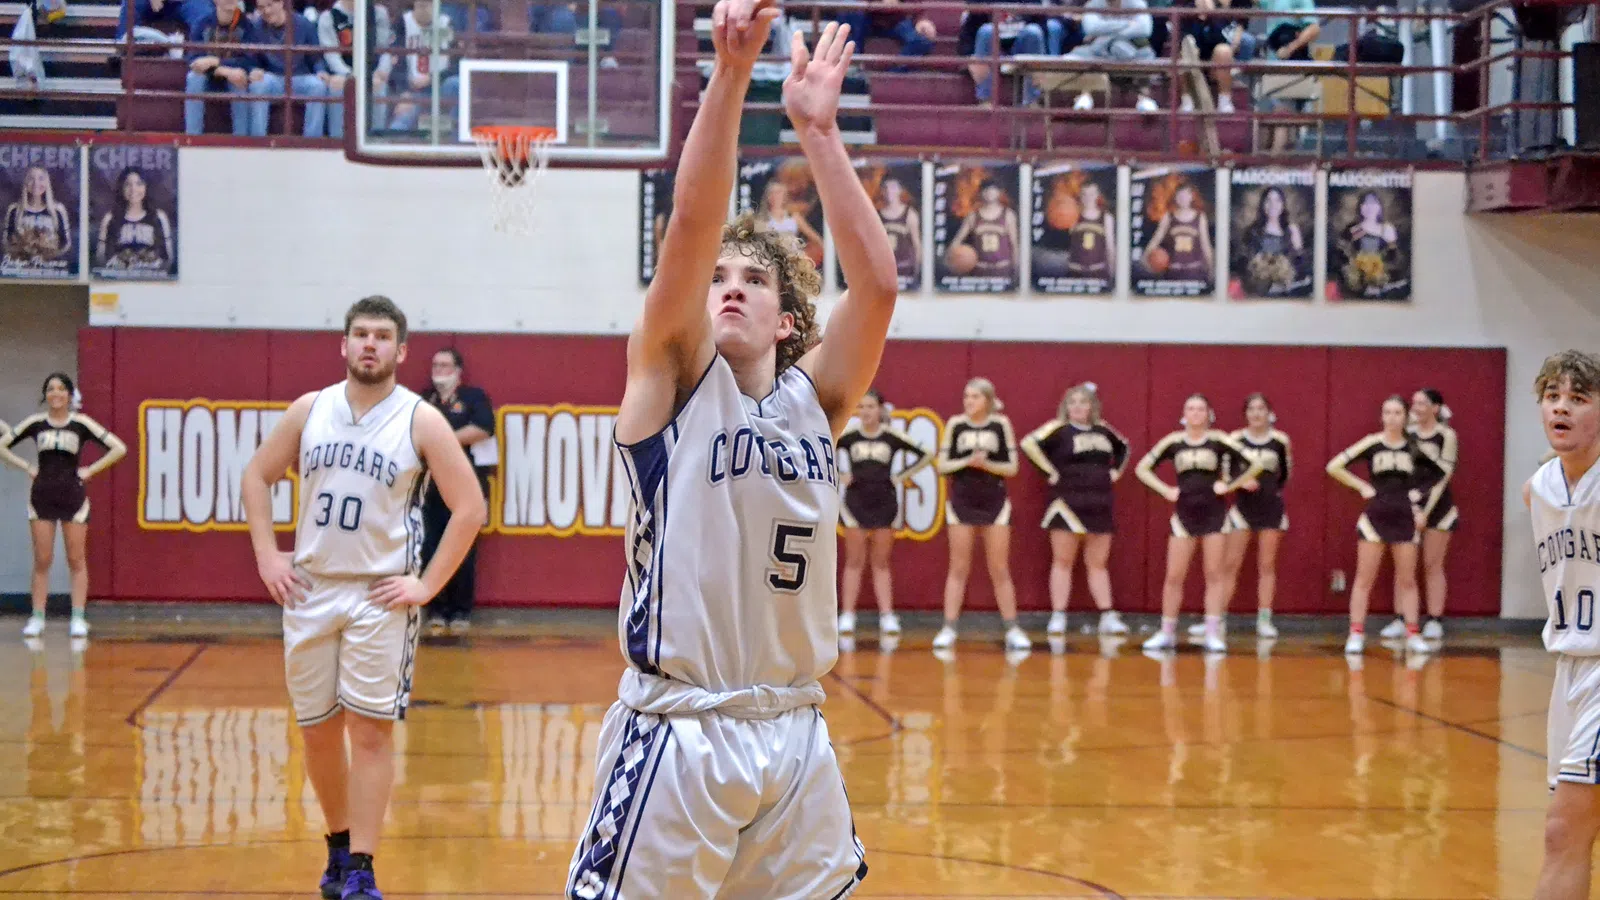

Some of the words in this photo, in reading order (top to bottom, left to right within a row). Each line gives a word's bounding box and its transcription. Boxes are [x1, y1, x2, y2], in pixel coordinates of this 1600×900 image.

[0, 146, 75, 169] CHEER
[93, 149, 172, 170] CHEER
[304, 442, 399, 488] COUGARS
[710, 427, 839, 489] COUGAR
[315, 491, 363, 532] 30
[767, 521, 815, 593] 5
[1553, 588, 1595, 632] 10
